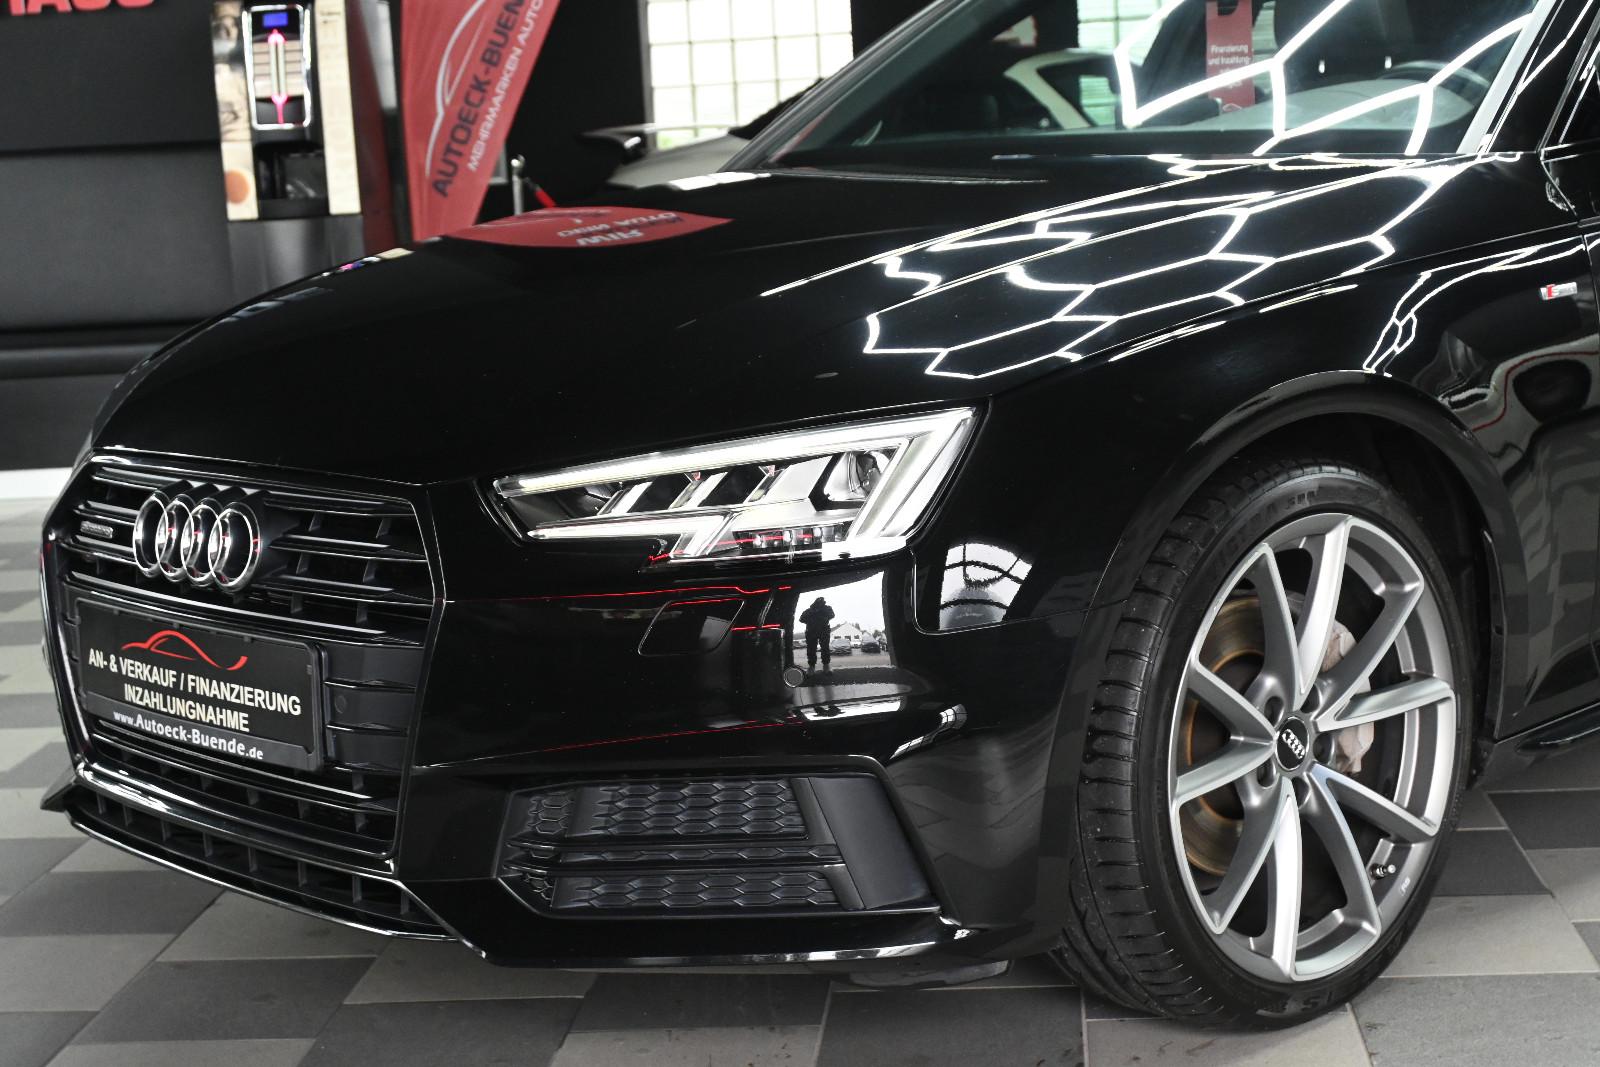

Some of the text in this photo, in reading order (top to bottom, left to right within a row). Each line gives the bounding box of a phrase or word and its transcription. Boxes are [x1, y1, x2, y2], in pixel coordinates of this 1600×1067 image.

[467, 46, 523, 172] MEHRMARKEN
[89, 648, 107, 668] AN-
[109, 655, 118, 673] &
[119, 656, 177, 689] VERKAUF
[187, 674, 301, 716] FINANZIERUNG
[124, 683, 250, 733] INZAHLUNGNAHME
[113, 709, 264, 760] www.Autoeck-Buende.de
